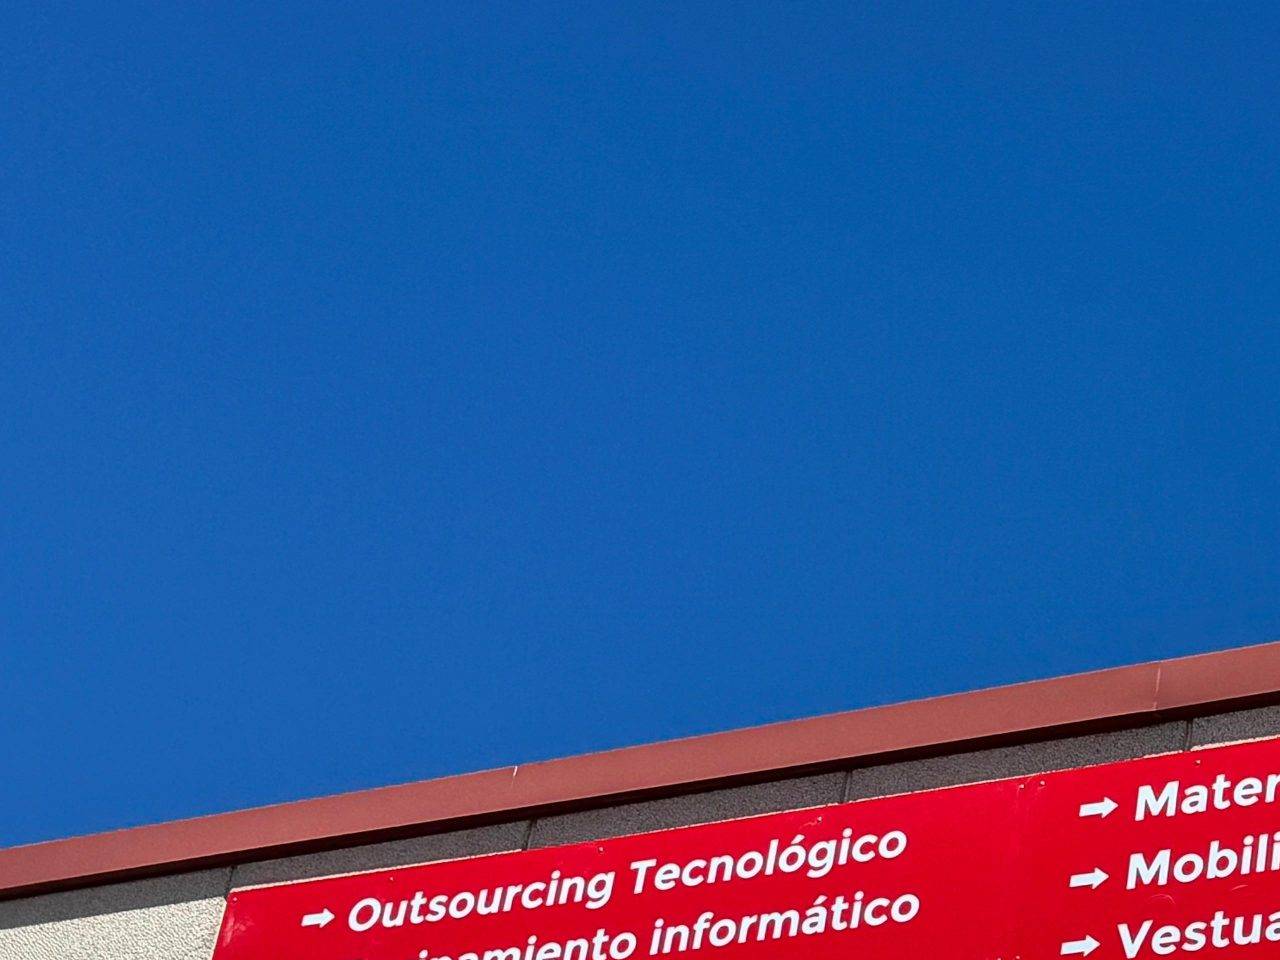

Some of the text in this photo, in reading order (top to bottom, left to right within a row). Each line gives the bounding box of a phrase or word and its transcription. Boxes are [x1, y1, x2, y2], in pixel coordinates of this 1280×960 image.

[347, 828, 908, 932] Outsourcing Tecnológico
[650, 893, 919, 955] informático
